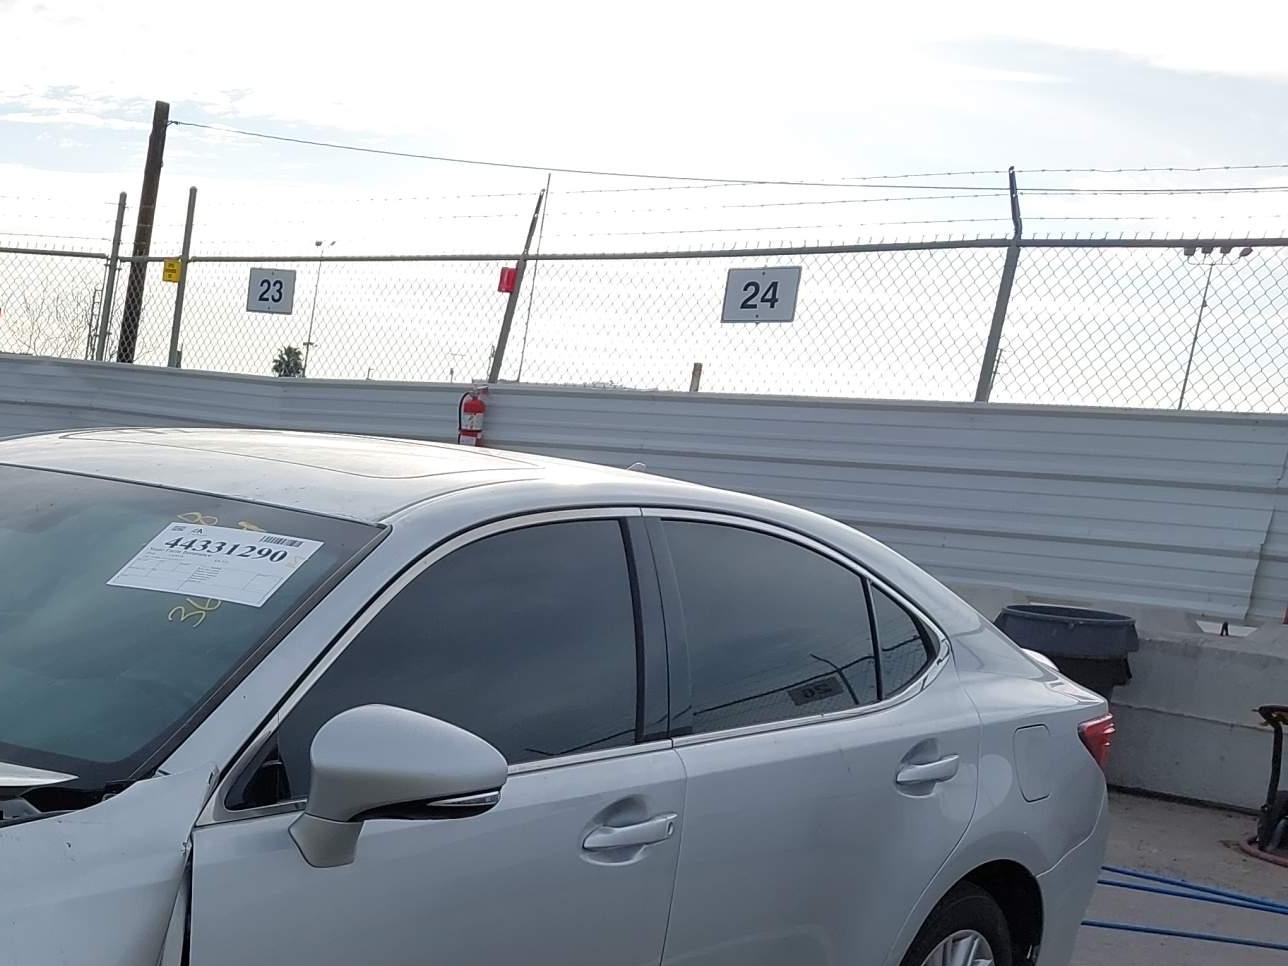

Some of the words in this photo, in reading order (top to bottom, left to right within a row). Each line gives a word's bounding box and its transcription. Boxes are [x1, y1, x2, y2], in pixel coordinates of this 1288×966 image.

[258, 279, 283, 303] 23
[739, 281, 780, 310] 24
[165, 537, 288, 563] 44331290
